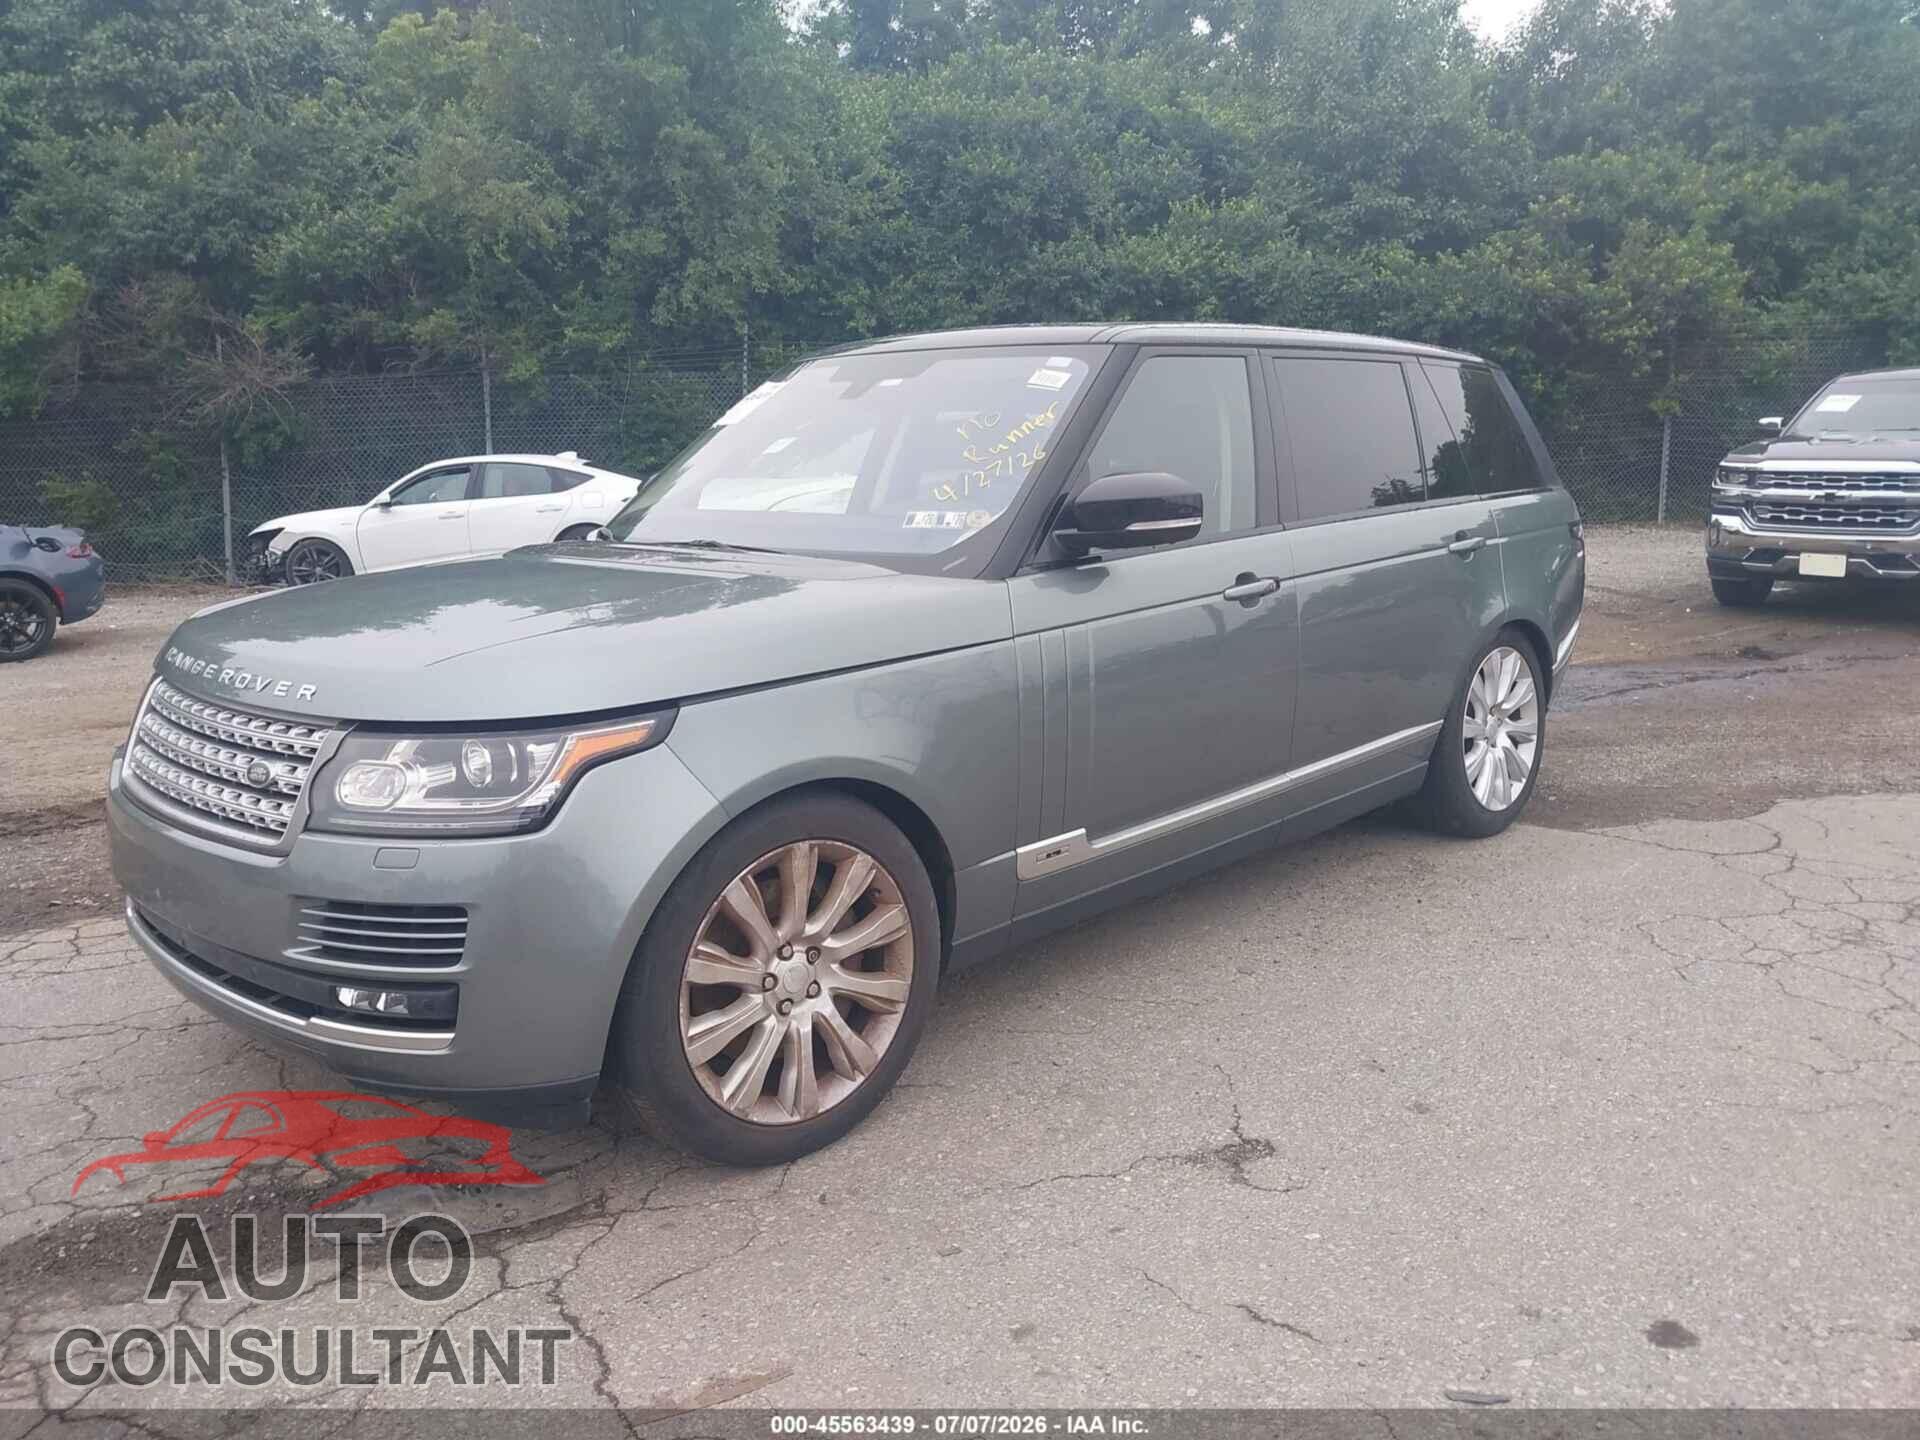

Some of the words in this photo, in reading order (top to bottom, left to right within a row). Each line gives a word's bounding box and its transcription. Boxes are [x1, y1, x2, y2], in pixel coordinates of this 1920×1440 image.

[962, 400, 1060, 463] Runner
[165, 646, 219, 679] RANGE
[218, 668, 317, 701] ROVER
